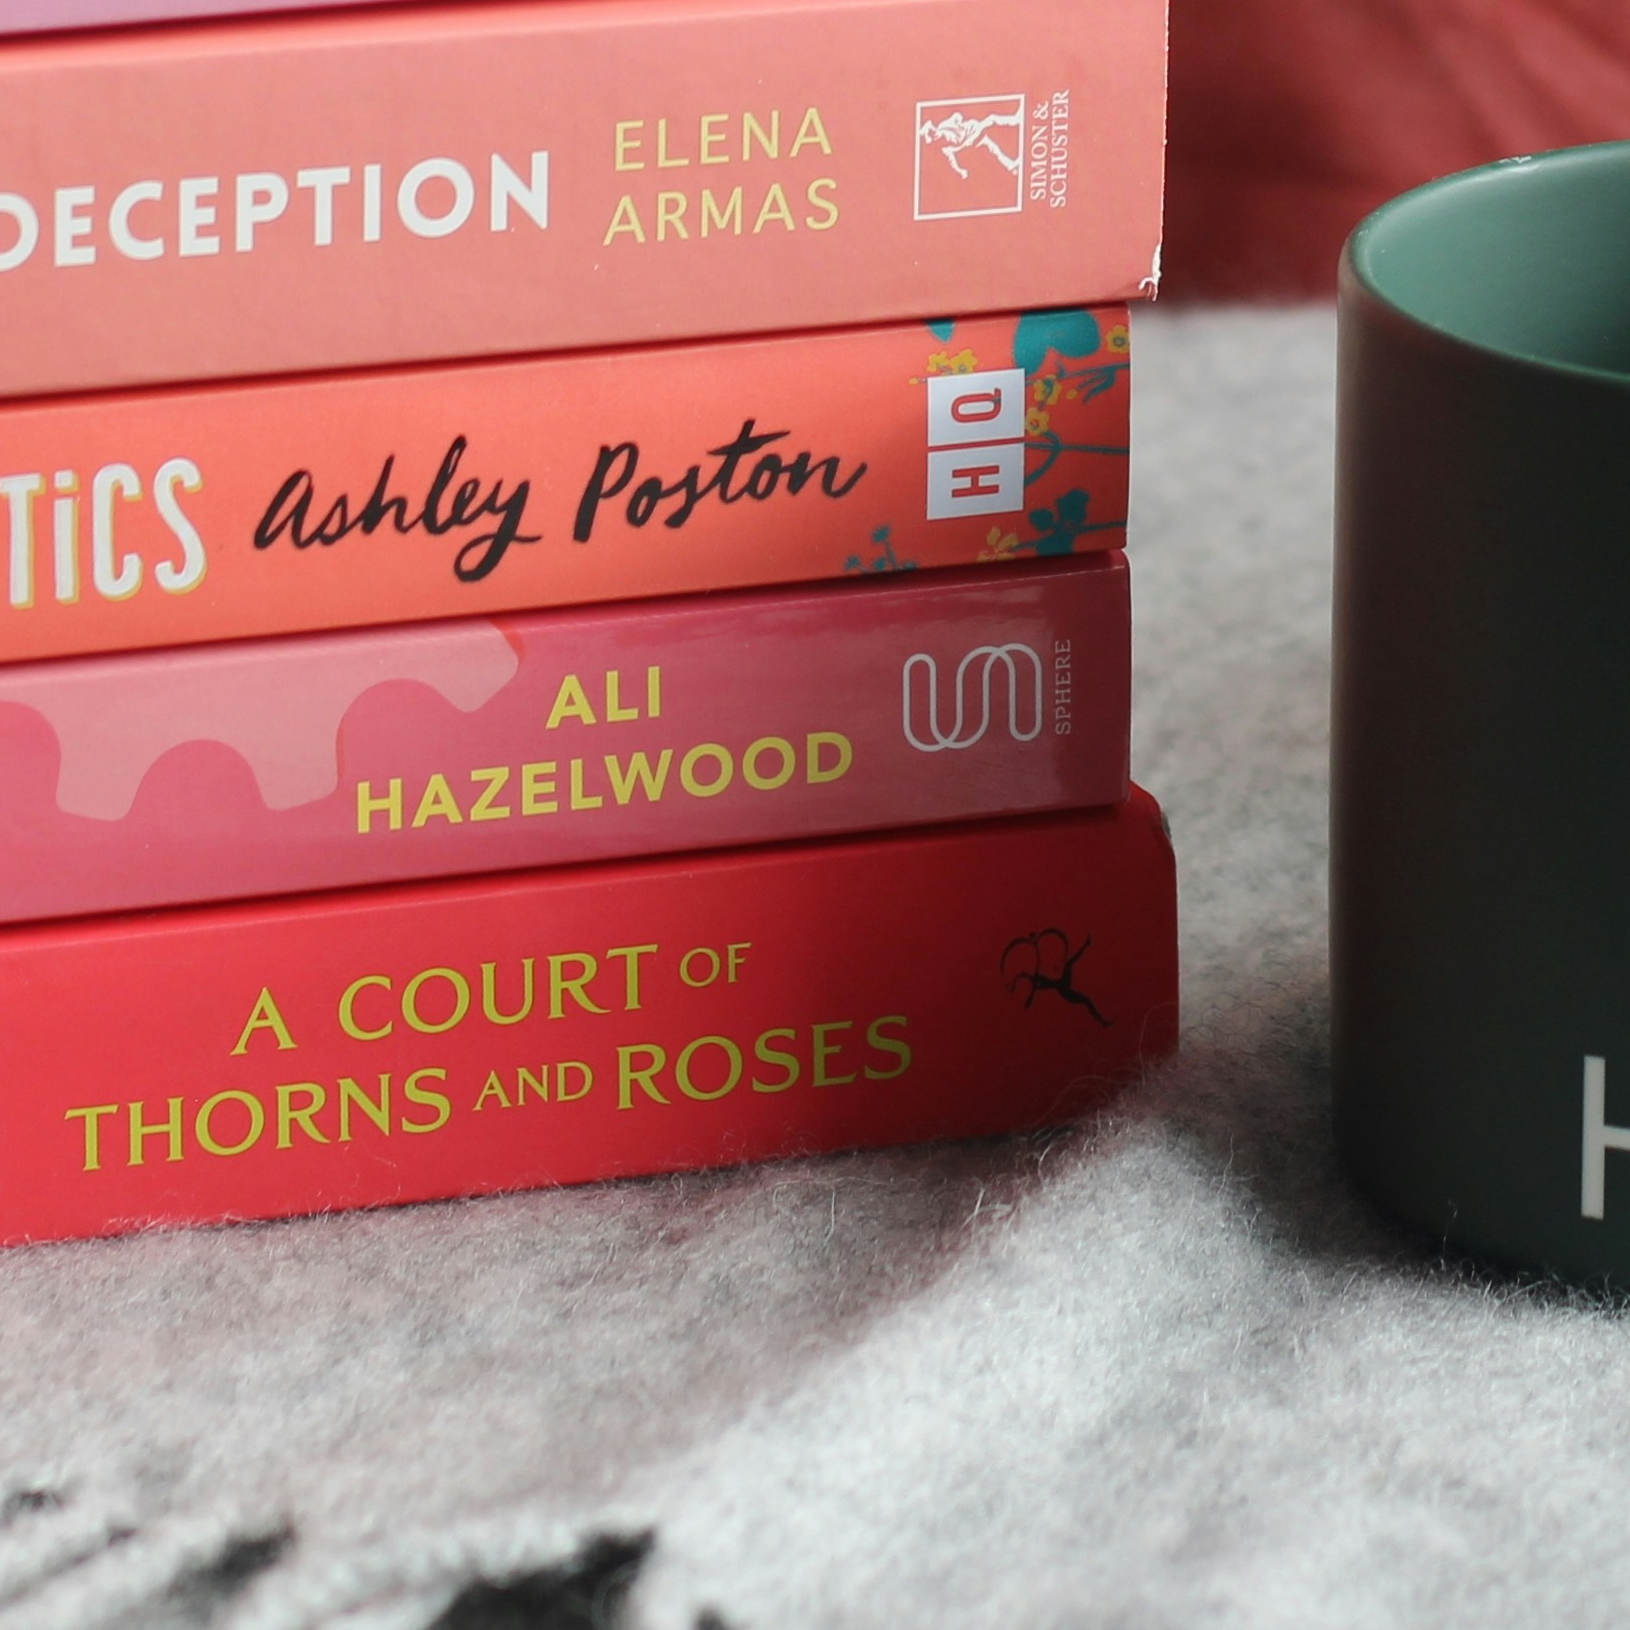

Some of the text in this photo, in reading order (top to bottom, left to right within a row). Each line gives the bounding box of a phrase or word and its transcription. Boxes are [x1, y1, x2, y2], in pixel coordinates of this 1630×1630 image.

[612, 106, 835, 172] ELENA
[1030, 100, 1049, 201] SIMON &
[1049, 89, 1070, 209] SCHUSTER
[603, 178, 841, 247] ARMAS
[252, 419, 868, 584] Ashley Poston
[544, 665, 664, 730] ALI
[1054, 638, 1072, 735] SPHERE
[356, 731, 855, 836] HAZELWOOD
[229, 941, 753, 1057] A COURT OF
[63, 1013, 915, 1174] THORNS AND ROSES
